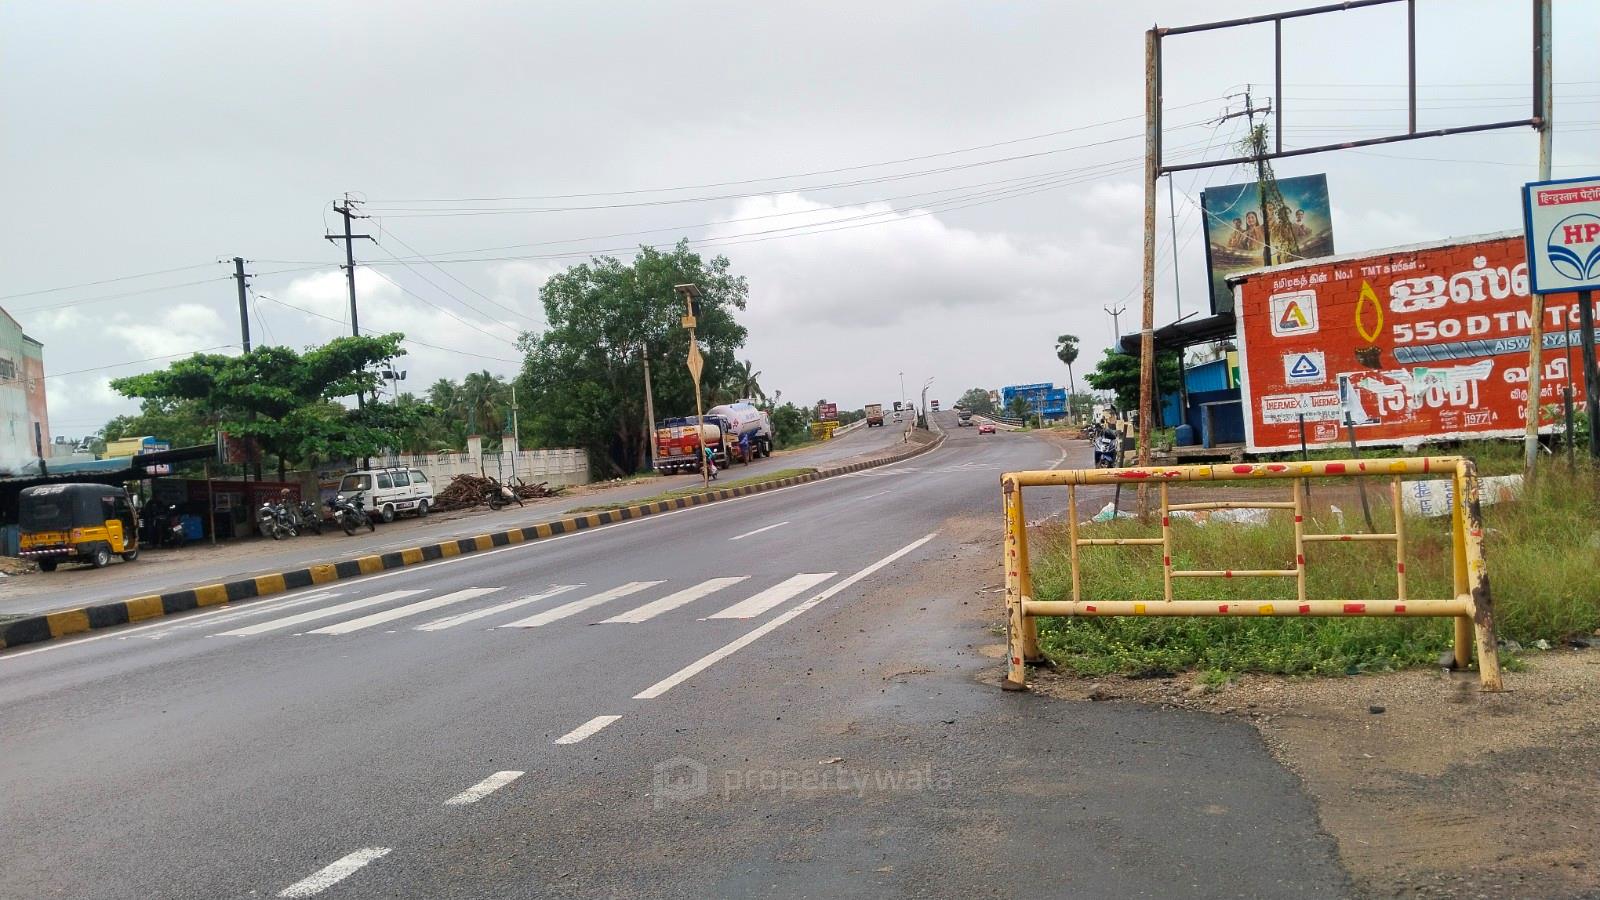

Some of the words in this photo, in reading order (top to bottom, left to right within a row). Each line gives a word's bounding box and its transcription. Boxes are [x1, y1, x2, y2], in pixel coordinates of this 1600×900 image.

[1563, 223, 1600, 245] HP
[1360, 264, 1382, 277] TMT
[1466, 413, 1488, 424] 1977
